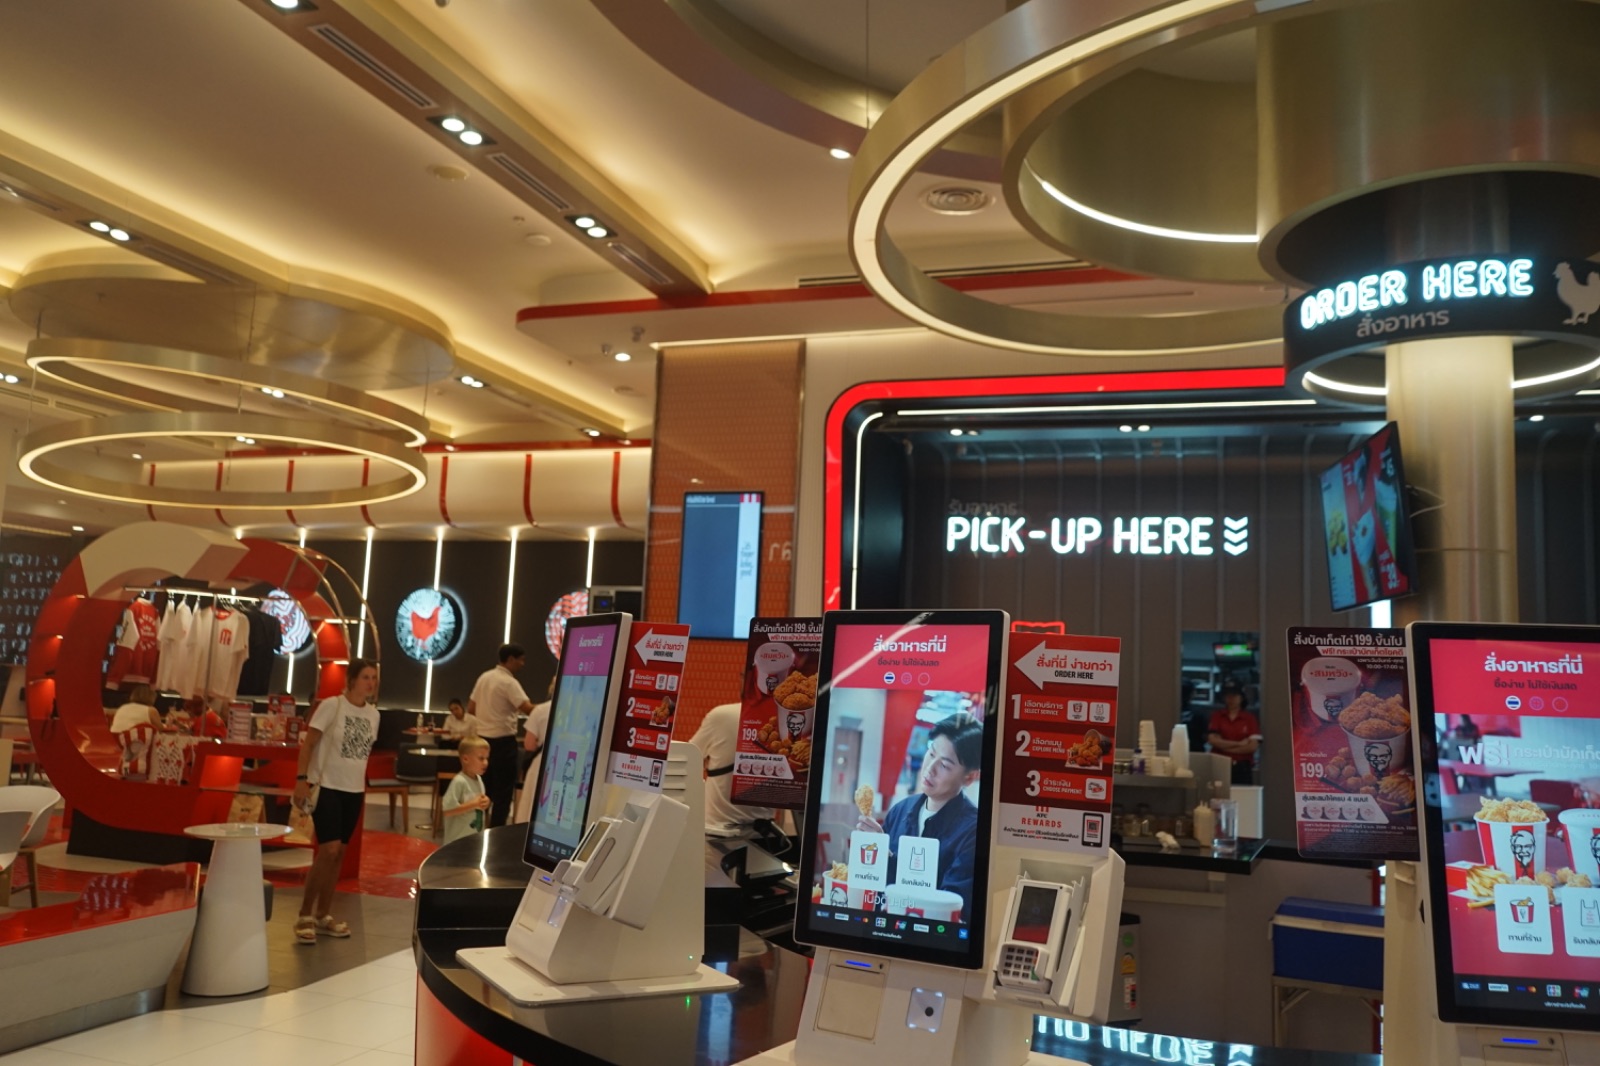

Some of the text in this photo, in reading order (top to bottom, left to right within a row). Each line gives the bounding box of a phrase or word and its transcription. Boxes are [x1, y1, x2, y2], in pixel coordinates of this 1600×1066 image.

[1300, 258, 1534, 330] ORDER HERE
[1355, 309, 1450, 339] สั่งอาหาร
[946, 516, 1214, 555] PICK-UP HERE
[808, 621, 823, 633] ขึ้นไ
[873, 635, 947, 652] สั่งอาหารที่นี่
[1293, 632, 1354, 646] สั่งบักเก็ตไก่
[1375, 633, 1403, 646] ขึ้นไป
[1036, 653, 1113, 672] สั่งที่นี่ ง่ายกว่า
[1484, 651, 1584, 675] สั่งอาหารที่นี่
[629, 669, 635, 689] 1
[1054, 670, 1094, 680] ORDER HERE
[626, 696, 636, 717] 2
[1011, 693, 1021, 720] 1
[627, 727, 637, 748] 3
[1015, 730, 1031, 757] 2
[1025, 769, 1041, 797] 3
[1021, 817, 1063, 829] REWARDS
